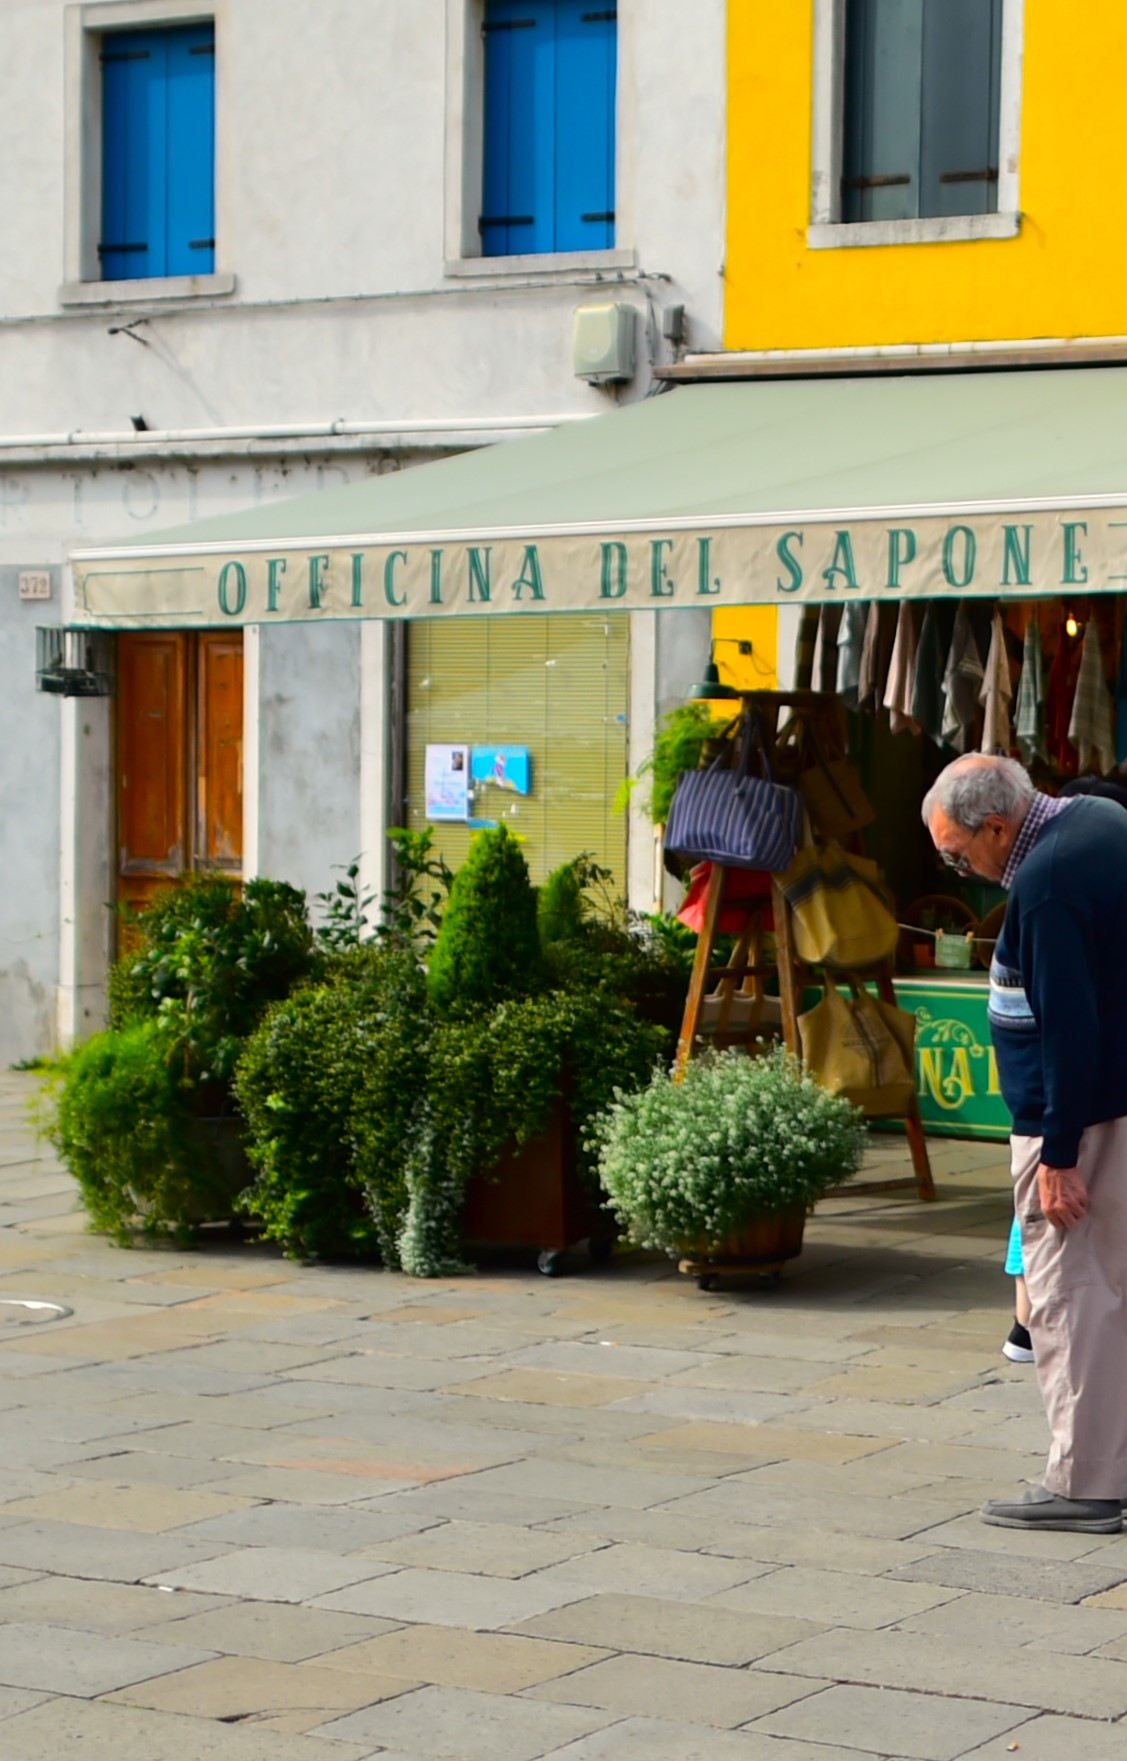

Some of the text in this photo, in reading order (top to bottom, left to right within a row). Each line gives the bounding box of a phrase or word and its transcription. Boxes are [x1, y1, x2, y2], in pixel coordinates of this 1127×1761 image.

[217, 522, 1088, 616] OFFICINA DEL SAPONE
